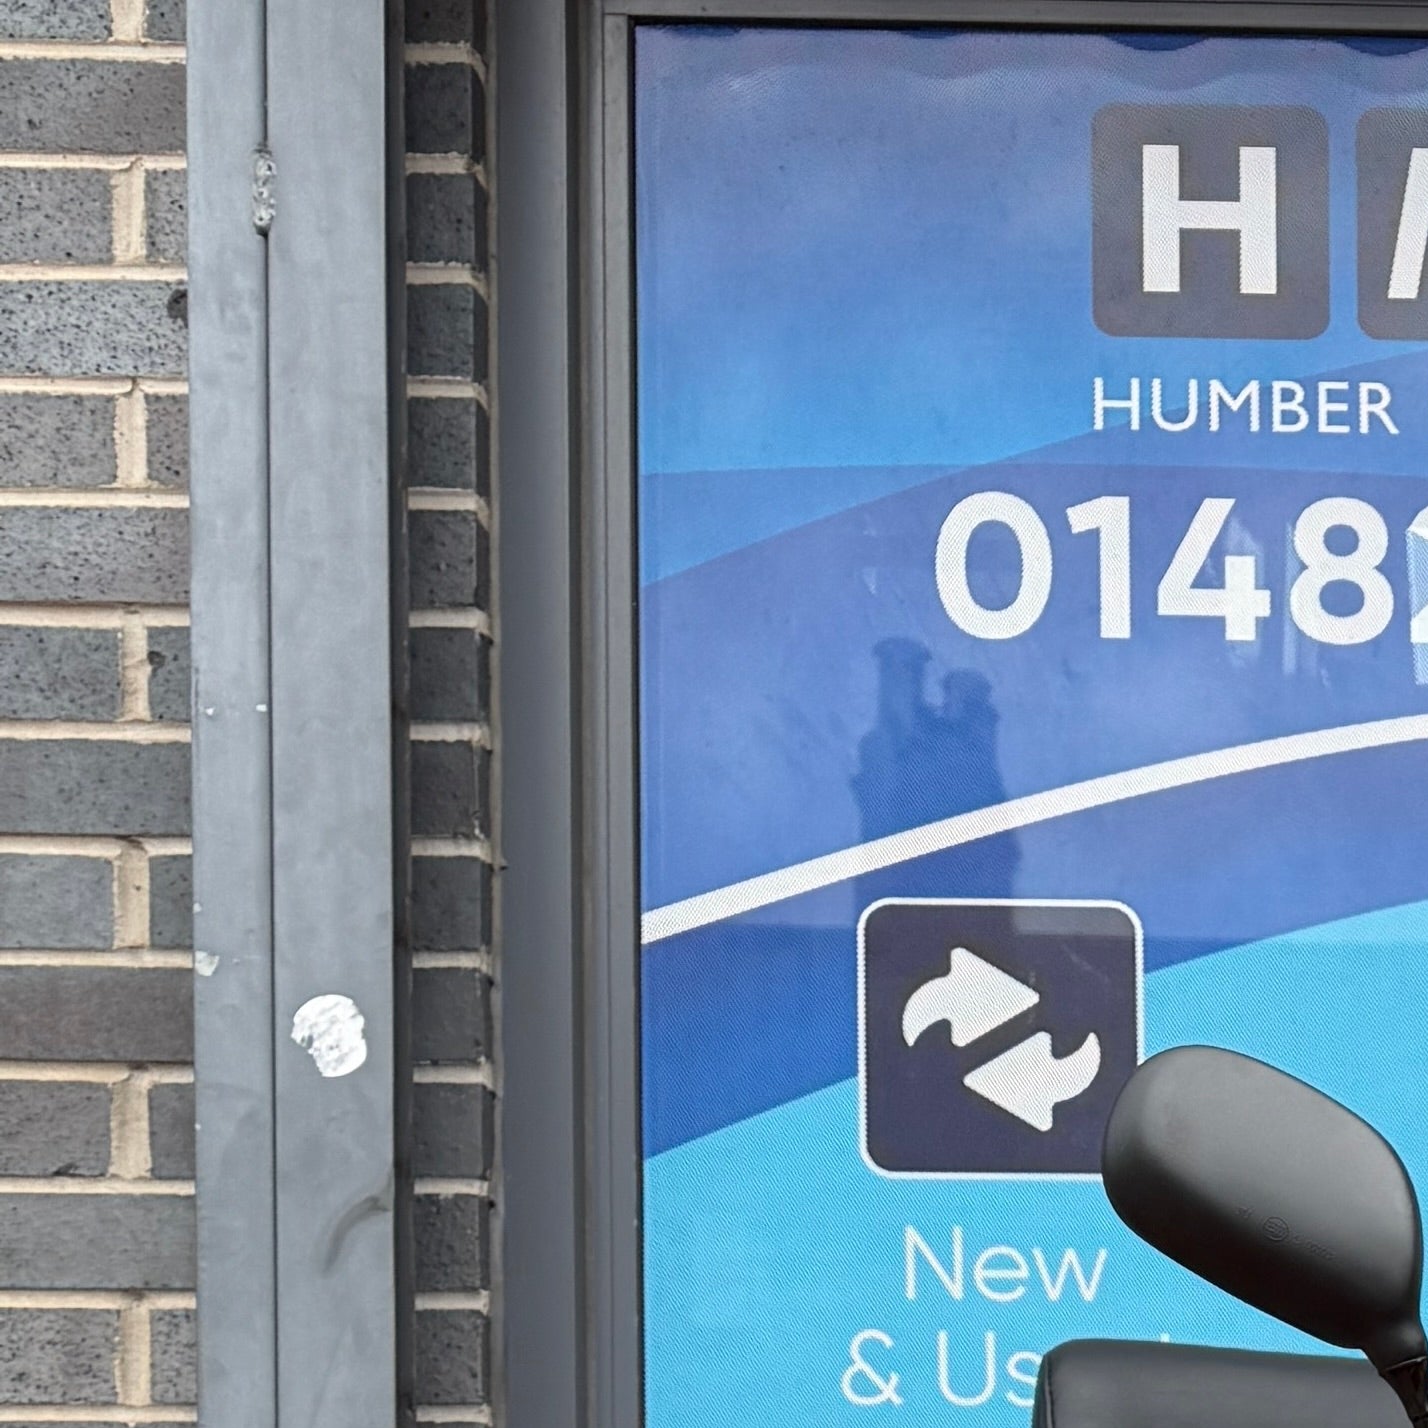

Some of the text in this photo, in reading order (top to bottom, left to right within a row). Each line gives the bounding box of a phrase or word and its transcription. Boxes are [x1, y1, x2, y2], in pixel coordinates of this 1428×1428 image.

[1093, 376, 1399, 438] HUMBER
[903, 1224, 1108, 1303] New
[839, 1328, 905, 1408] &
